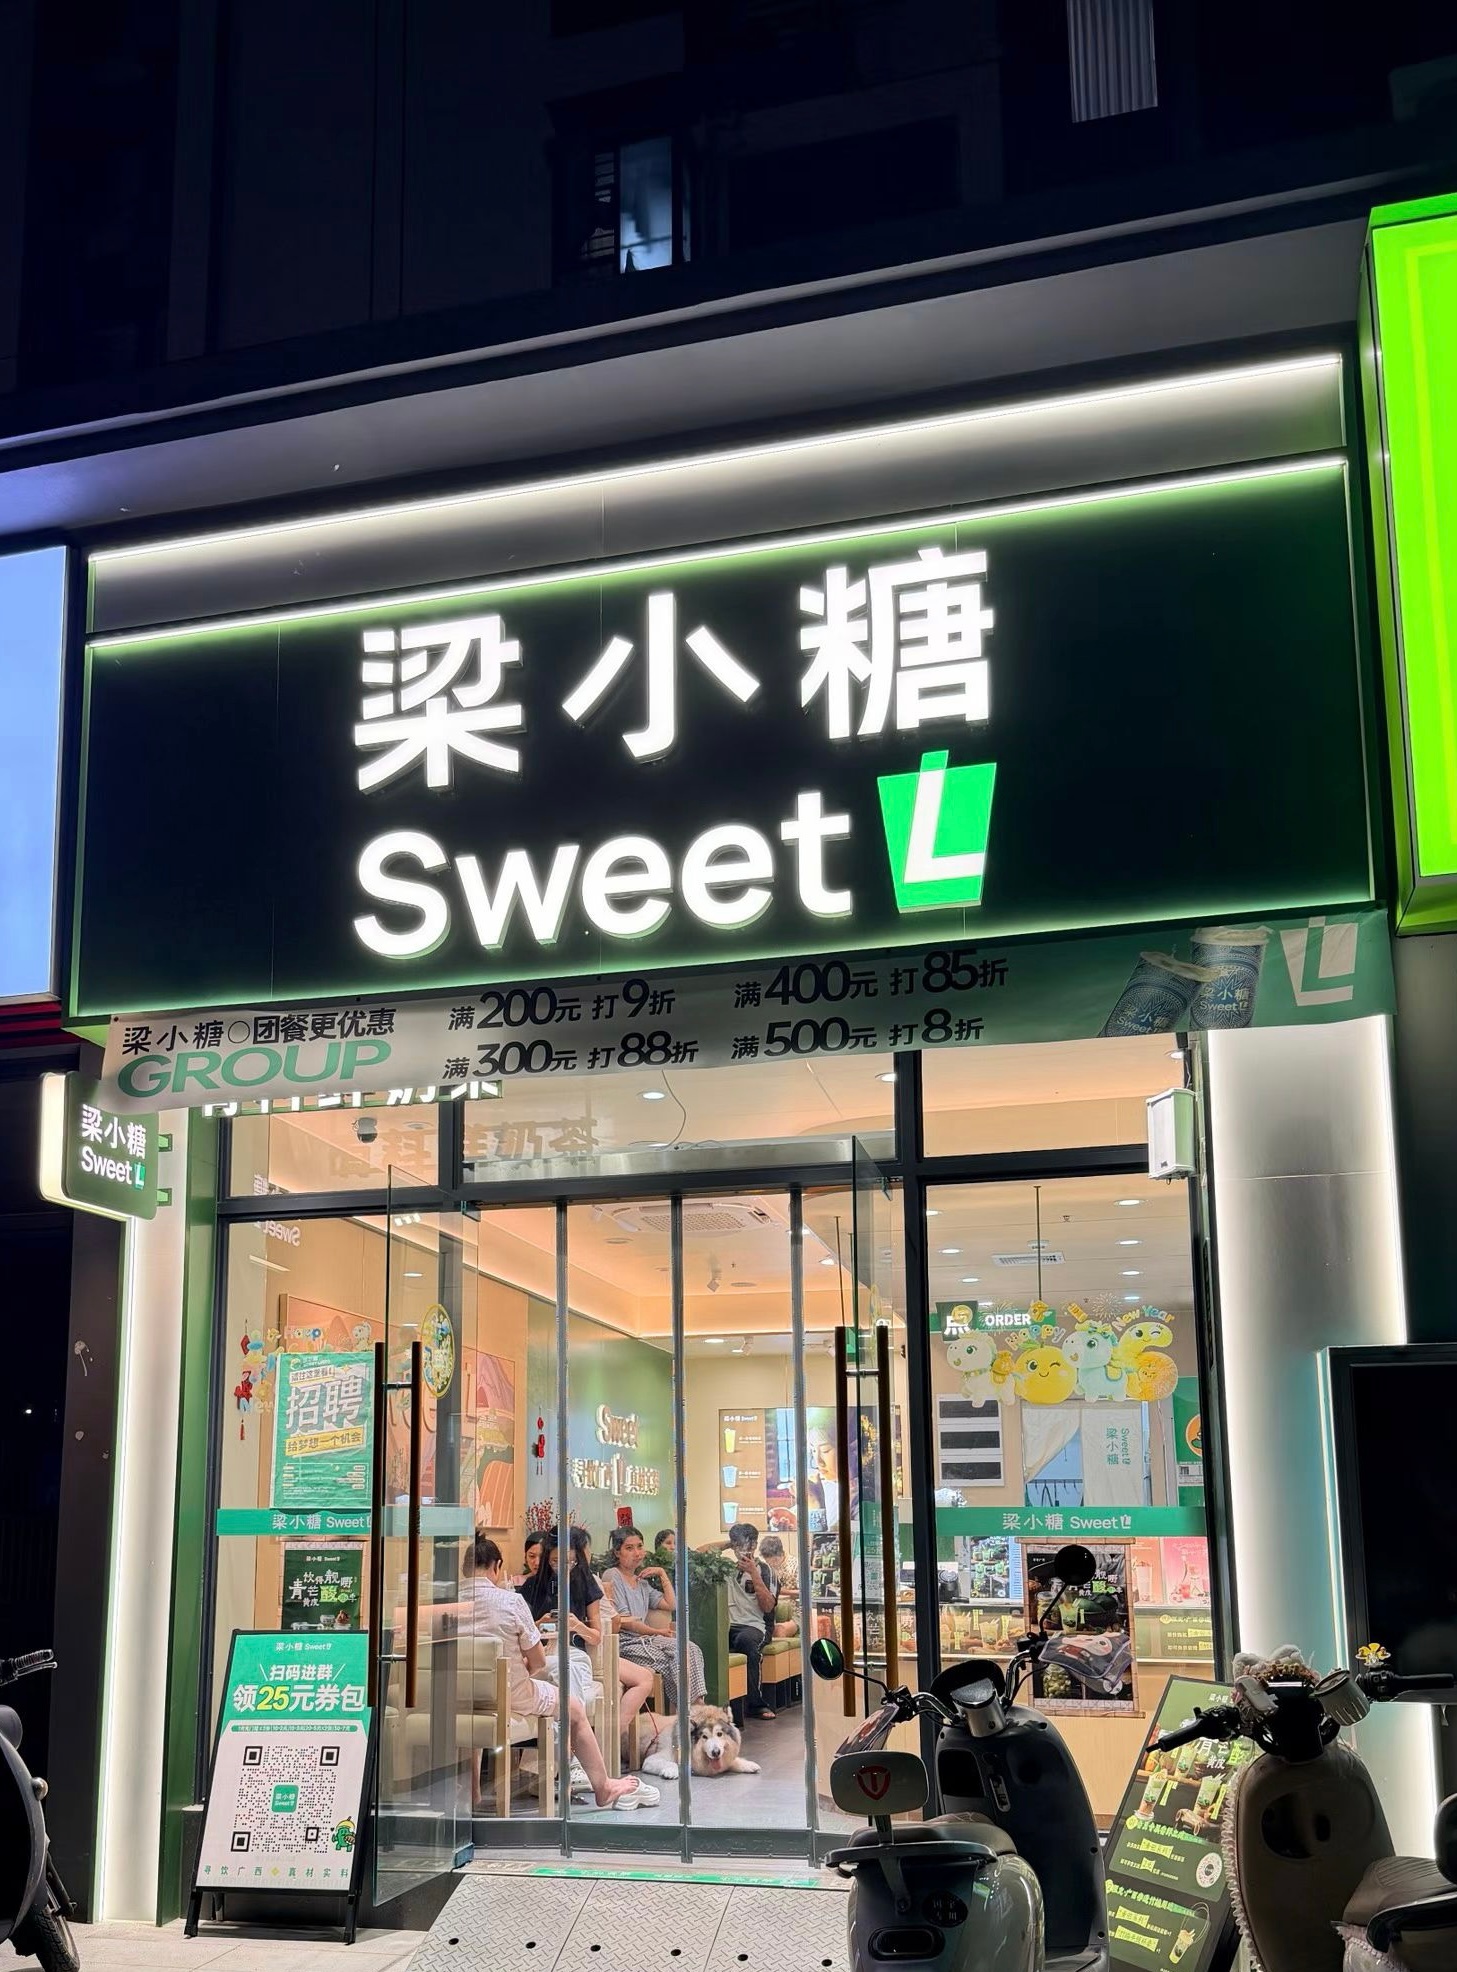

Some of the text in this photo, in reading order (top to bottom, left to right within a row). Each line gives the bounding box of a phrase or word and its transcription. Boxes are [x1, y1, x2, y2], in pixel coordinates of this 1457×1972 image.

[353, 547, 994, 793] 梁小糖
[354, 791, 853, 959] Sweet
[734, 949, 1008, 1009] 满400元 打85折
[448, 978, 675, 1032] 满200元 打9折
[1200, 1000, 1239, 1011] Sweet
[122, 1007, 397, 1056] 梁小糖 团餐更优惠
[730, 1008, 986, 1060] 满500元 打8折
[118, 1039, 391, 1098] GROUP
[443, 1030, 700, 1080] 满300元 打88折
[81, 1103, 147, 1160] 梁小糖
[81, 1145, 133, 1185] Sweet
[985, 1313, 1032, 1326] ORDER
[1112, 1305, 1175, 1332] New Year
[1005, 1324, 1066, 1351] Happy
[286, 1375, 363, 1429] 招聘
[287, 1431, 362, 1453] 给梦想一个机会
[1106, 1427, 1119, 1465] 梁小糖
[1121, 1427, 1130, 1457] Sweet
[272, 1514, 364, 1530] 梁小糖 Sweet
[1002, 1512, 1064, 1531] 梁小糖
[1070, 1516, 1118, 1530] Sweet
[276, 1642, 326, 1651] 梁小糖 Sweet
[269, 1664, 333, 1681] 扫码进群
[233, 1684, 365, 1712] 领25元券包
[203, 1865, 349, 1878] 寻饮广西 真材实料
